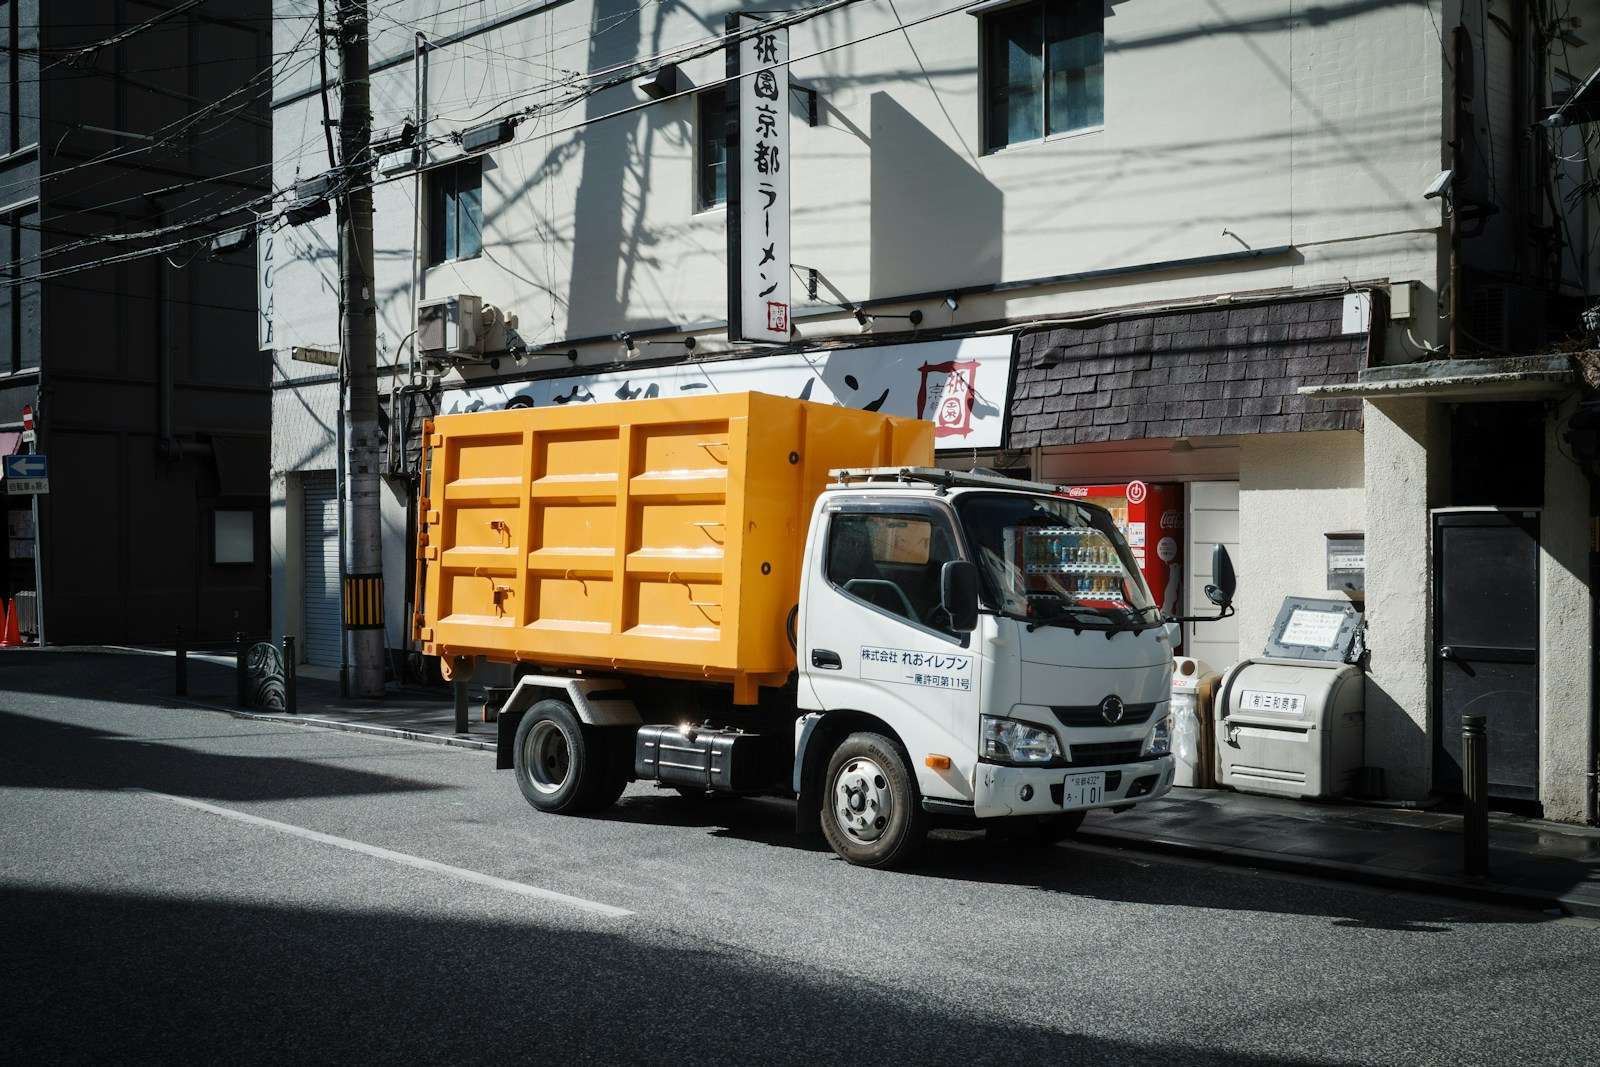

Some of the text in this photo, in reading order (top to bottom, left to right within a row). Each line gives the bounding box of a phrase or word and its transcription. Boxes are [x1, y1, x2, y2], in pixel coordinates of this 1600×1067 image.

[861, 649, 968, 670] 株式会社 れおイレブン
